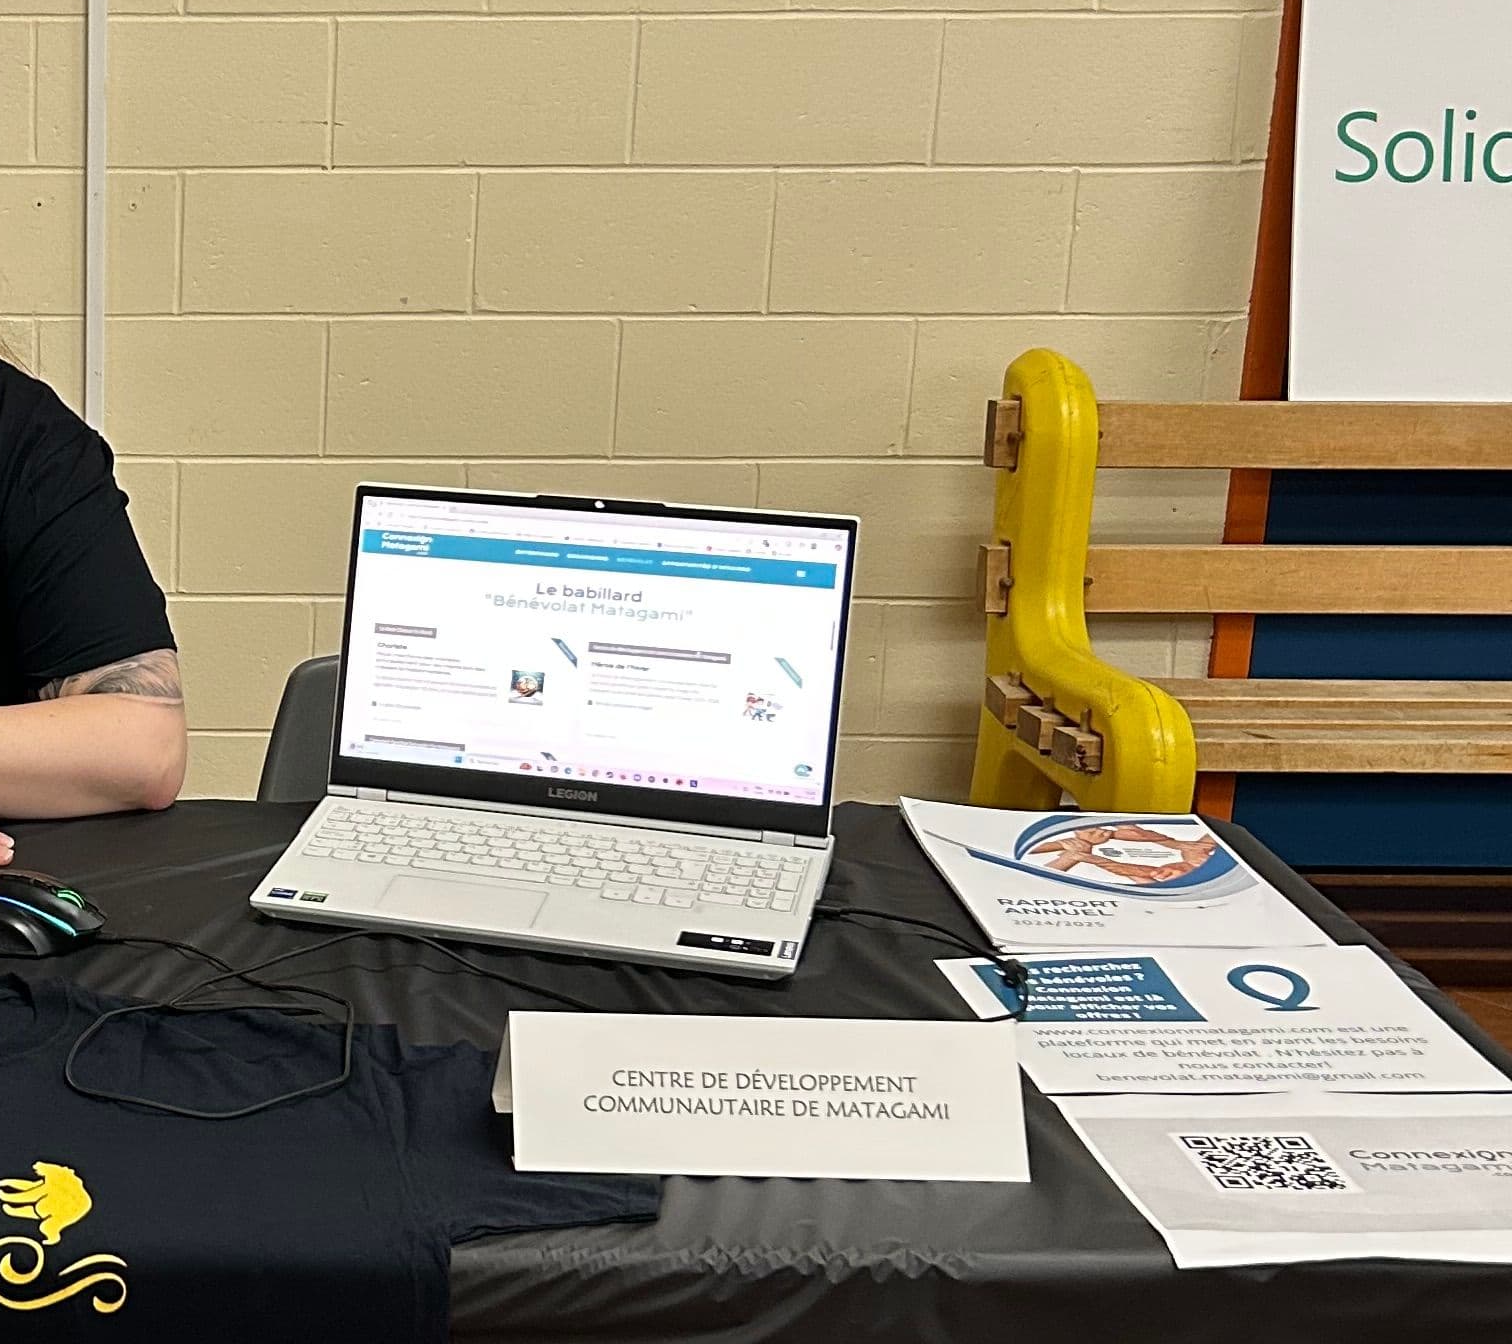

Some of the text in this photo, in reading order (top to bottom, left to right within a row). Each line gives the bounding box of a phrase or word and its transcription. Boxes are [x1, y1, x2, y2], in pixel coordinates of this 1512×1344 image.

[536, 583, 643, 602] Le babillard
[548, 787, 598, 802] LEGION
[997, 898, 1120, 908] RAPPORT
[1005, 907, 1115, 917] ANNUEL
[1014, 920, 1106, 928] 2024/2025
[1042, 962, 1142, 975] recherchez
[1040, 974, 1132, 984] bénévoles
[1026, 1004, 1066, 1012] pour
[1070, 1003, 1141, 1011] afficher
[1033, 1025, 1409, 1036] www.connexionmatagami.com est une
[1038, 1036, 1429, 1048] plateforme qui met en avant les besoins
[1063, 1049, 1126, 1058] locaux
[1133, 1049, 1158, 1058] de
[1163, 1049, 1259, 1058] bénévolat
[1275, 1048, 1366, 1057] N'hésitez
[1371, 1048, 1402, 1058] pas
[1412, 1048, 1425, 1057] à
[612, 1069, 917, 1093] CENTRE DE DÉVELOPPEMENT
[583, 1095, 951, 1120] COMMUNAUTAIRE DE MATAGAMI
